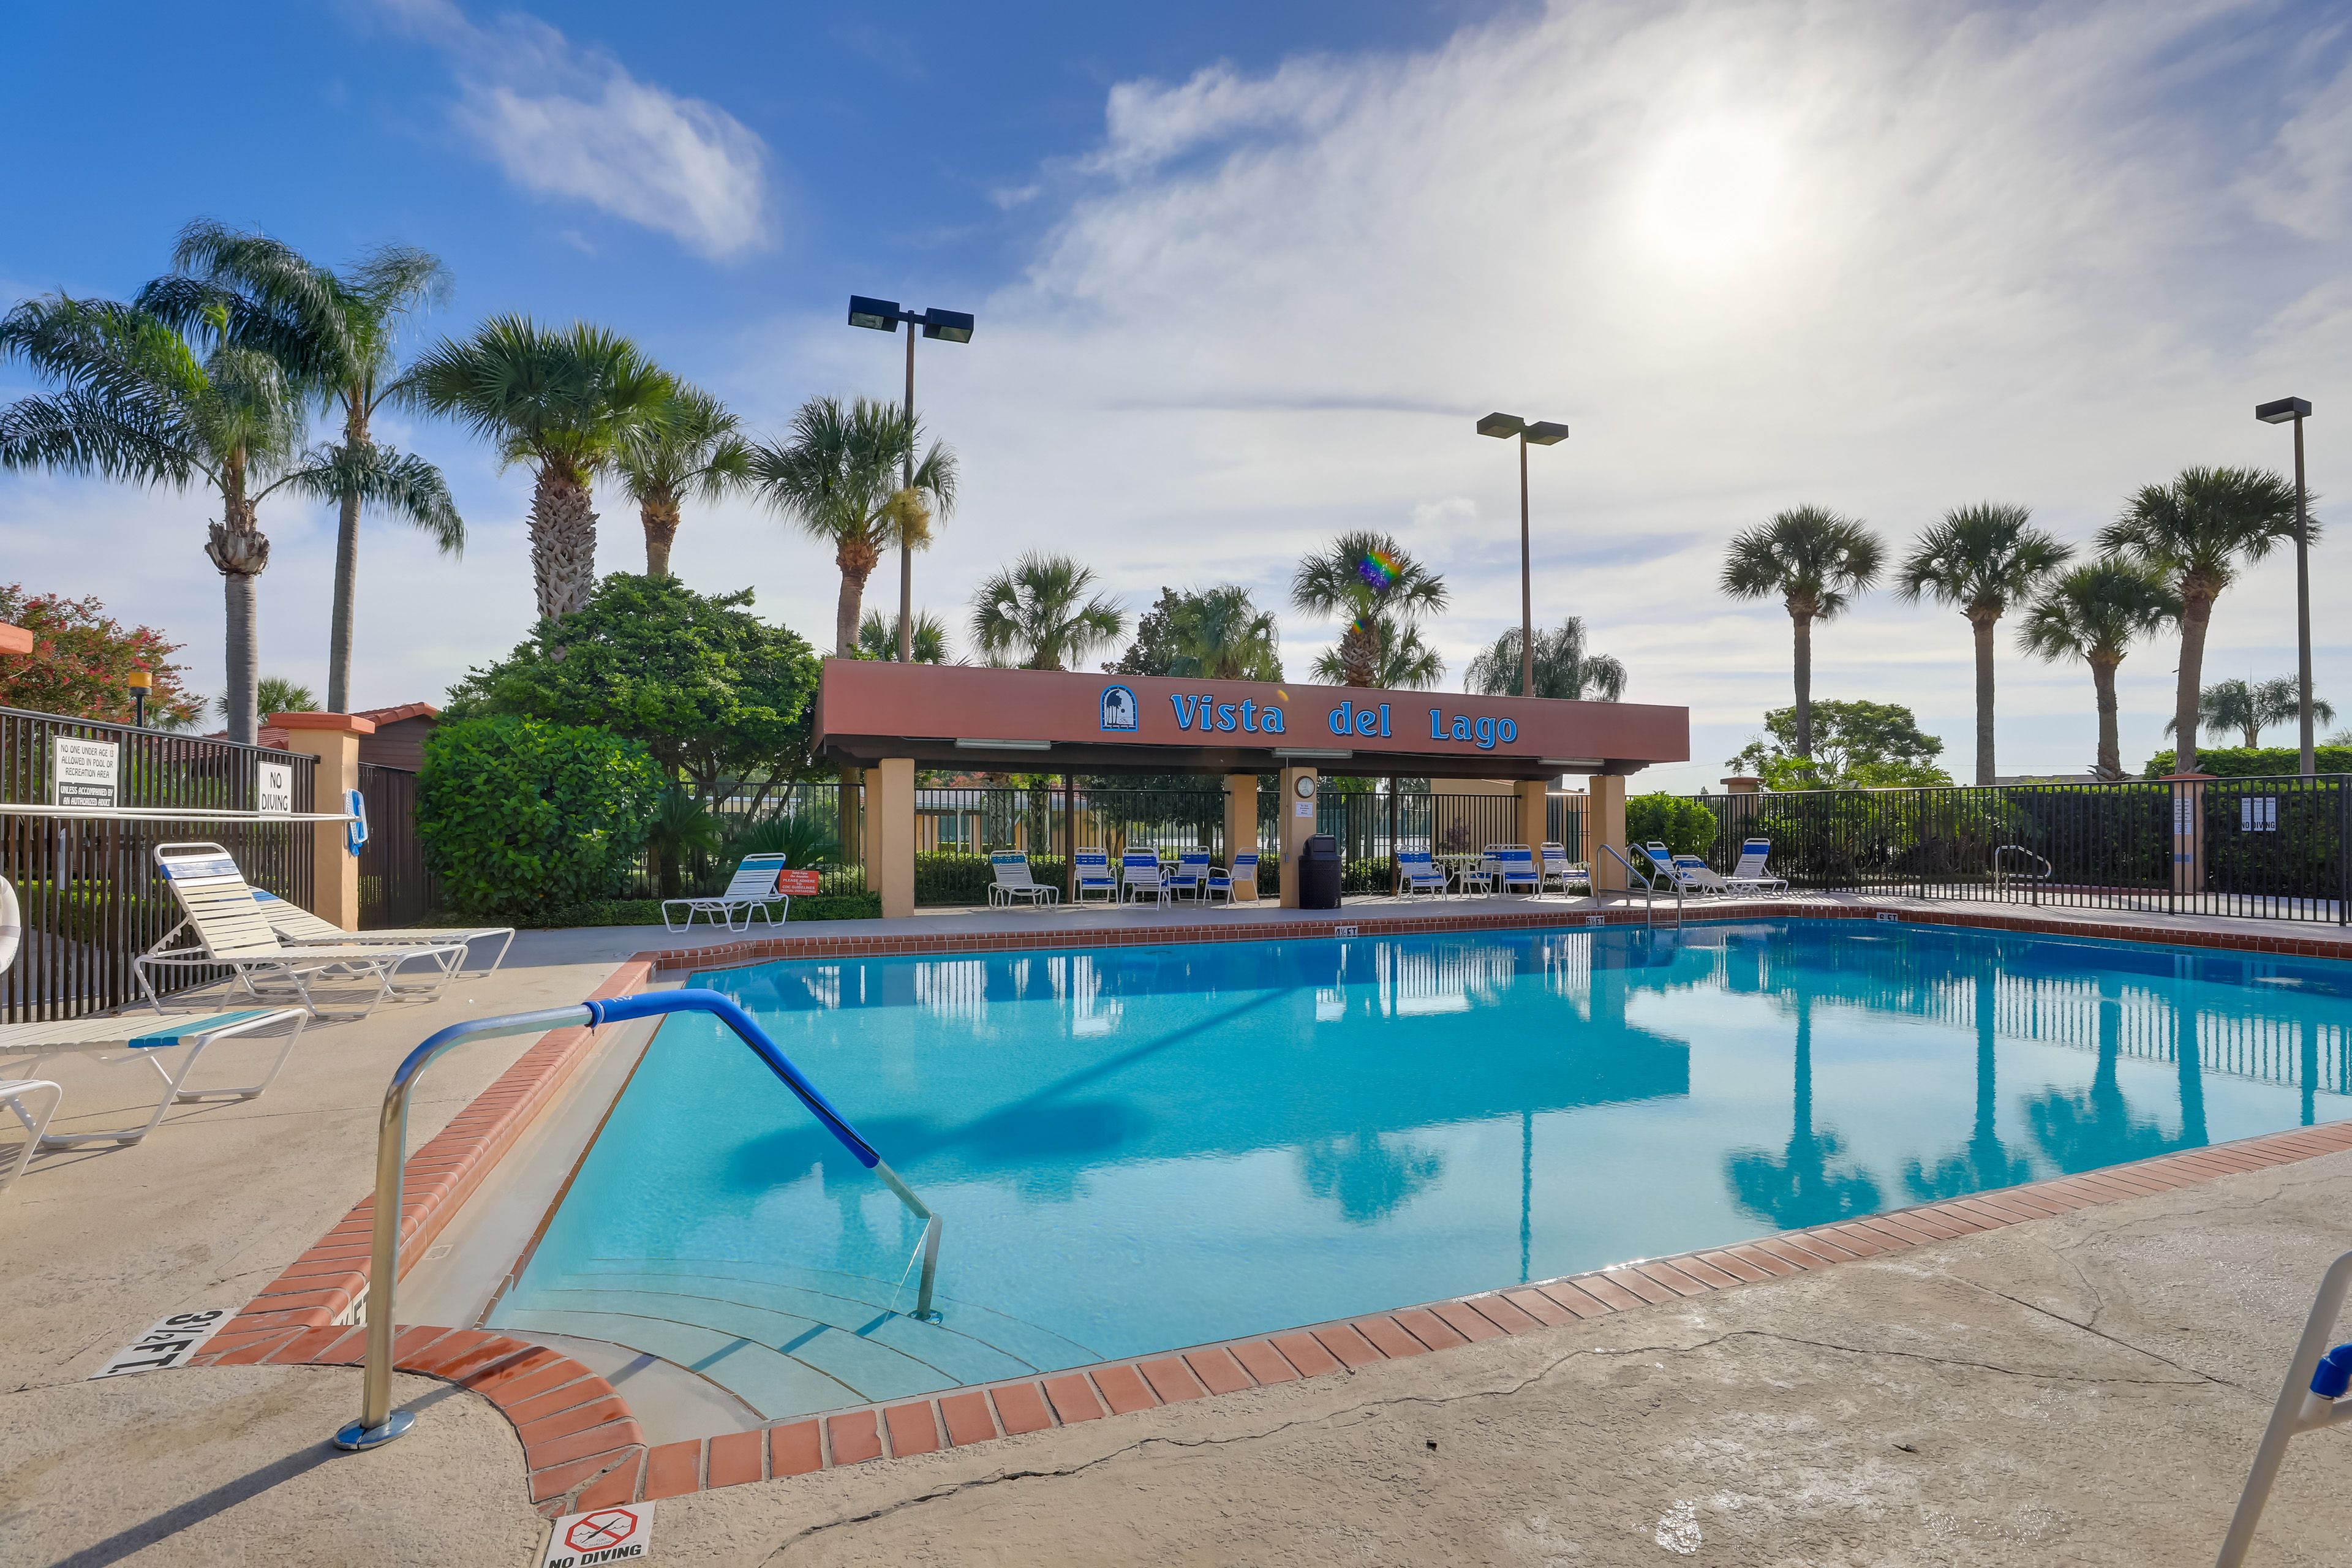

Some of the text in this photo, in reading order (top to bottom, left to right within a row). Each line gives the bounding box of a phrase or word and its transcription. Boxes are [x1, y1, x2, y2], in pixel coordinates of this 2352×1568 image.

[1169, 693, 1518, 750] Vista del Lago
[61, 744, 68, 753] NO
[70, 745, 80, 754] ONE
[81, 747, 97, 756] UNDER
[99, 748, 108, 757] AGE
[61, 756, 85, 766] ALLOWED
[86, 758, 91, 766] IN
[92, 759, 105, 767] POOL
[66, 767, 96, 777] RECREATION
[270, 772, 282, 789] NO
[60, 785, 78, 794] UNLESS
[78, 786, 107, 796] ACCOMPANIED
[63, 796, 70, 805] AN
[70, 797, 97, 805] AUTHORIZED
[262, 793, 288, 811] DIVING
[548, 1544, 642, 1568] NO DIVING
